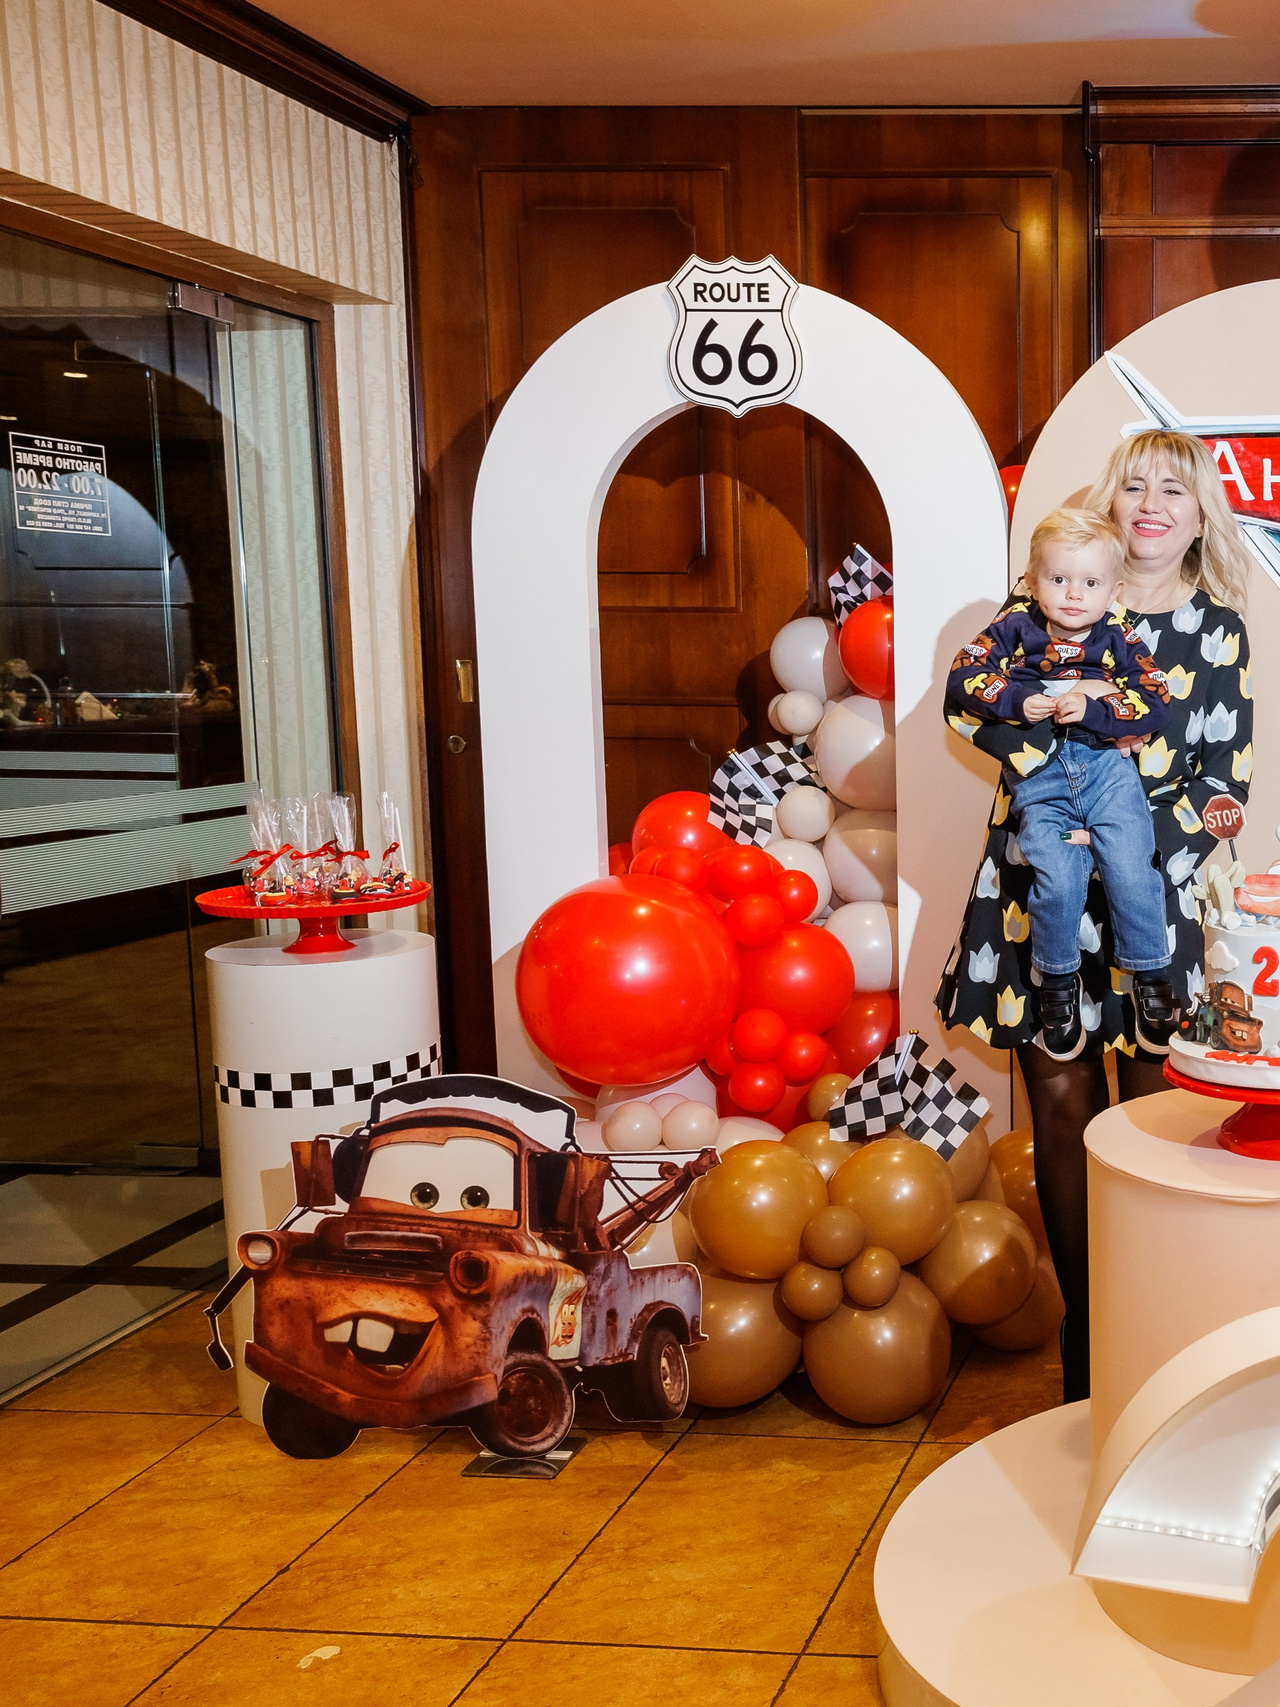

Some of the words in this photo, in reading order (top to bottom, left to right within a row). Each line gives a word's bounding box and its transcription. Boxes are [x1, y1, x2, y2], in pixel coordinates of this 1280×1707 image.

[693, 282, 770, 303] ROUTE
[692, 317, 778, 386] 66
[1057, 646, 1079, 656] GUESS
[985, 680, 1002, 698] HONEY
[1206, 808, 1241, 829] STOP
[1252, 945, 1280, 998] 2
